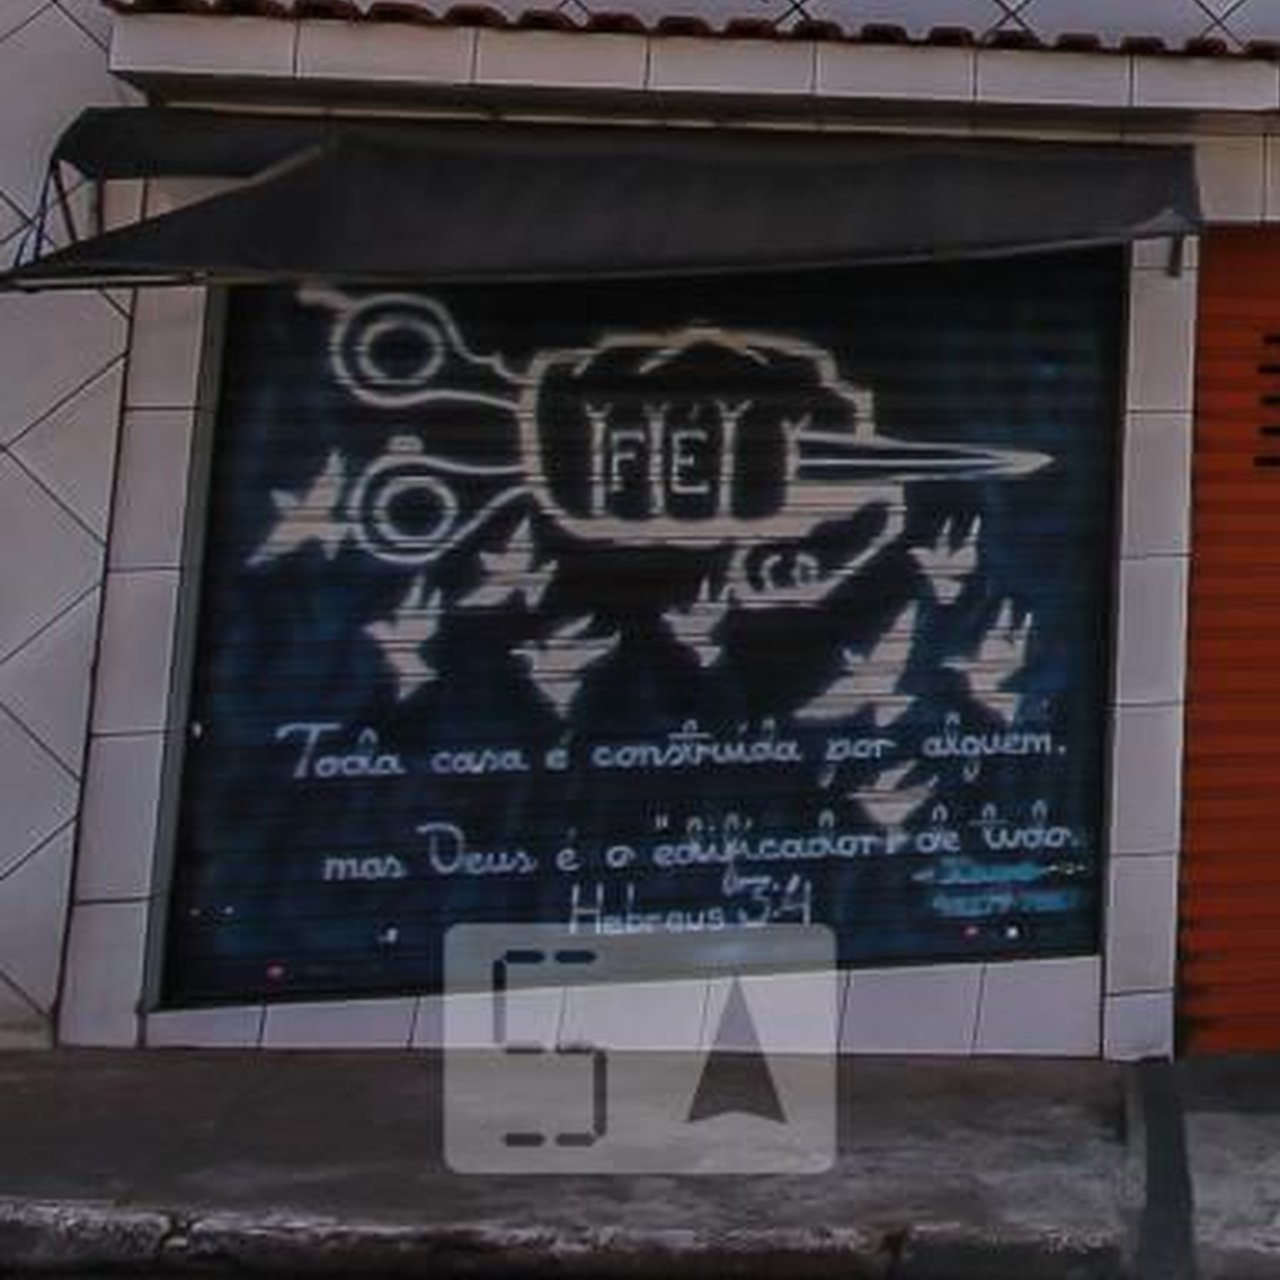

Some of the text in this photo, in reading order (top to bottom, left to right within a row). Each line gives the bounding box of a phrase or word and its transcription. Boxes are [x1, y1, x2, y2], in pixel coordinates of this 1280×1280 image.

[275, 721, 407, 778] Toda
[430, 749, 529, 773] casa
[323, 853, 407, 880] mas
[415, 821, 539, 874] Deus
